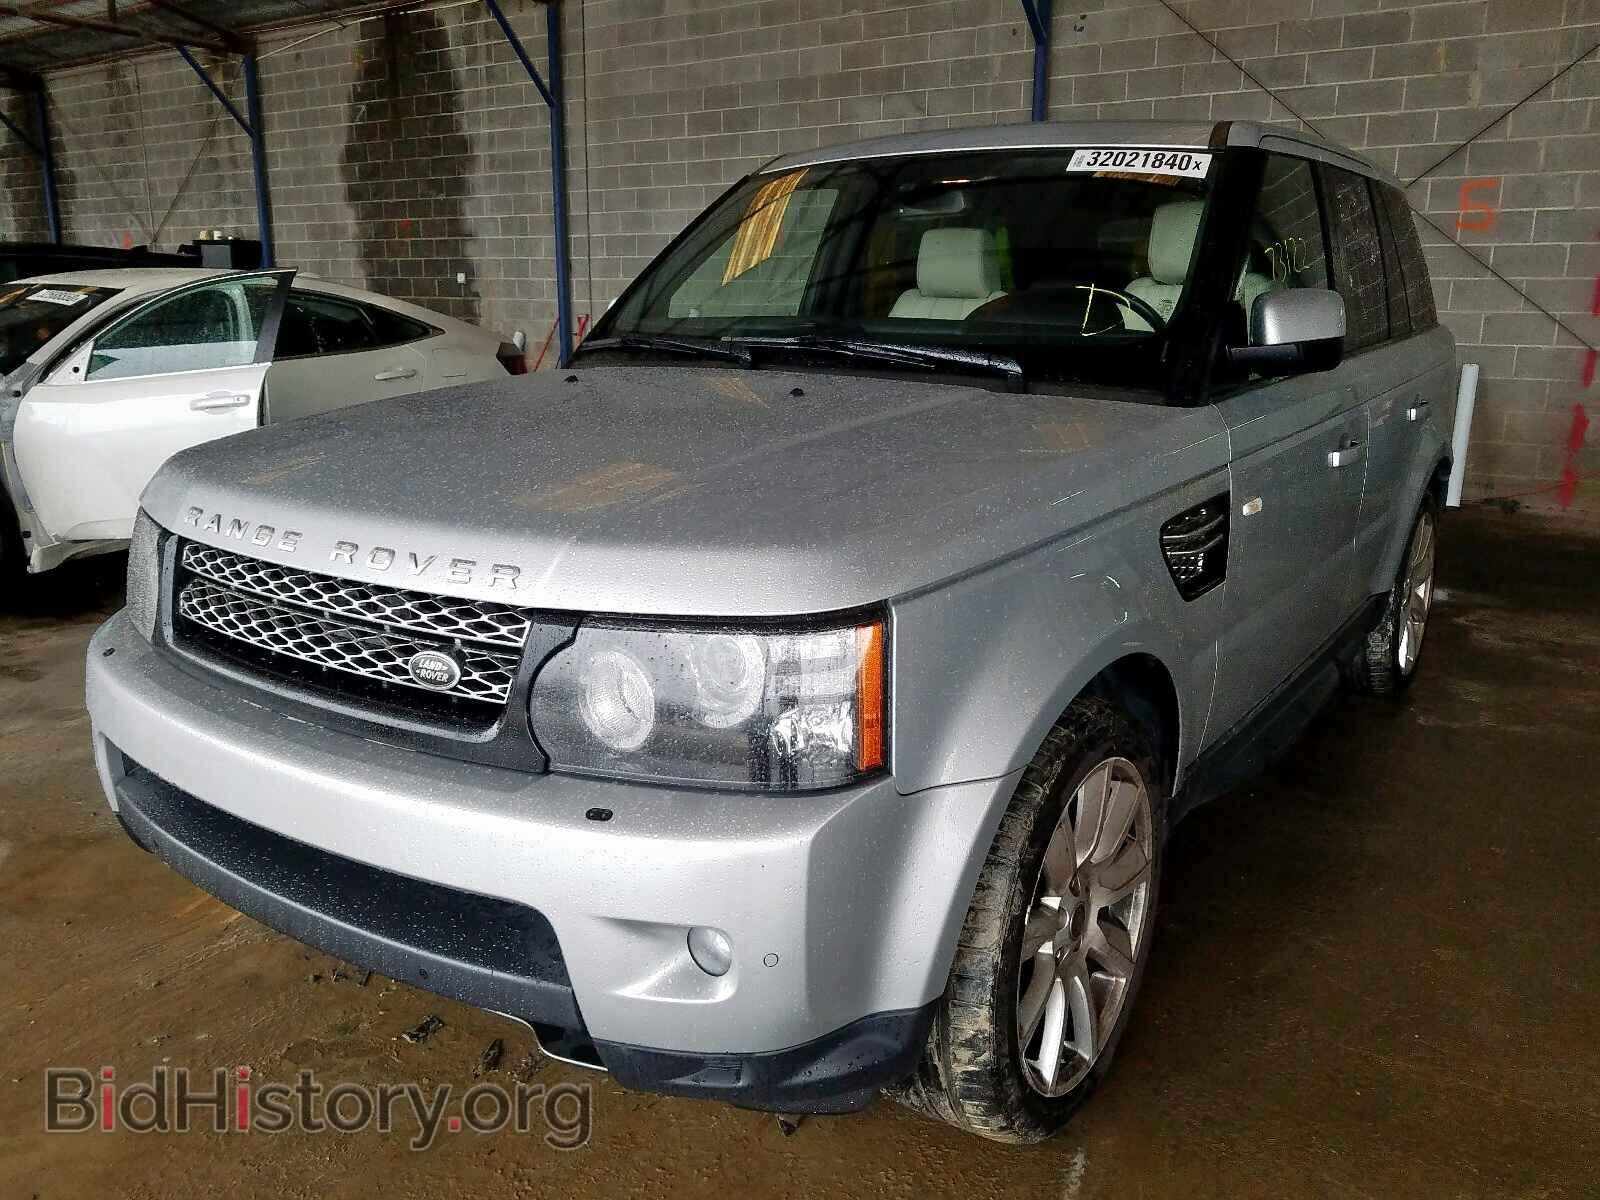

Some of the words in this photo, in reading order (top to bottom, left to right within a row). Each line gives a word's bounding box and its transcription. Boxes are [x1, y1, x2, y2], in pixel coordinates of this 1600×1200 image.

[184, 505, 303, 553] RANGE
[329, 540, 521, 590] ROVER
[418, 658, 443, 671] LAND
[419, 669, 449, 683] ROVER
